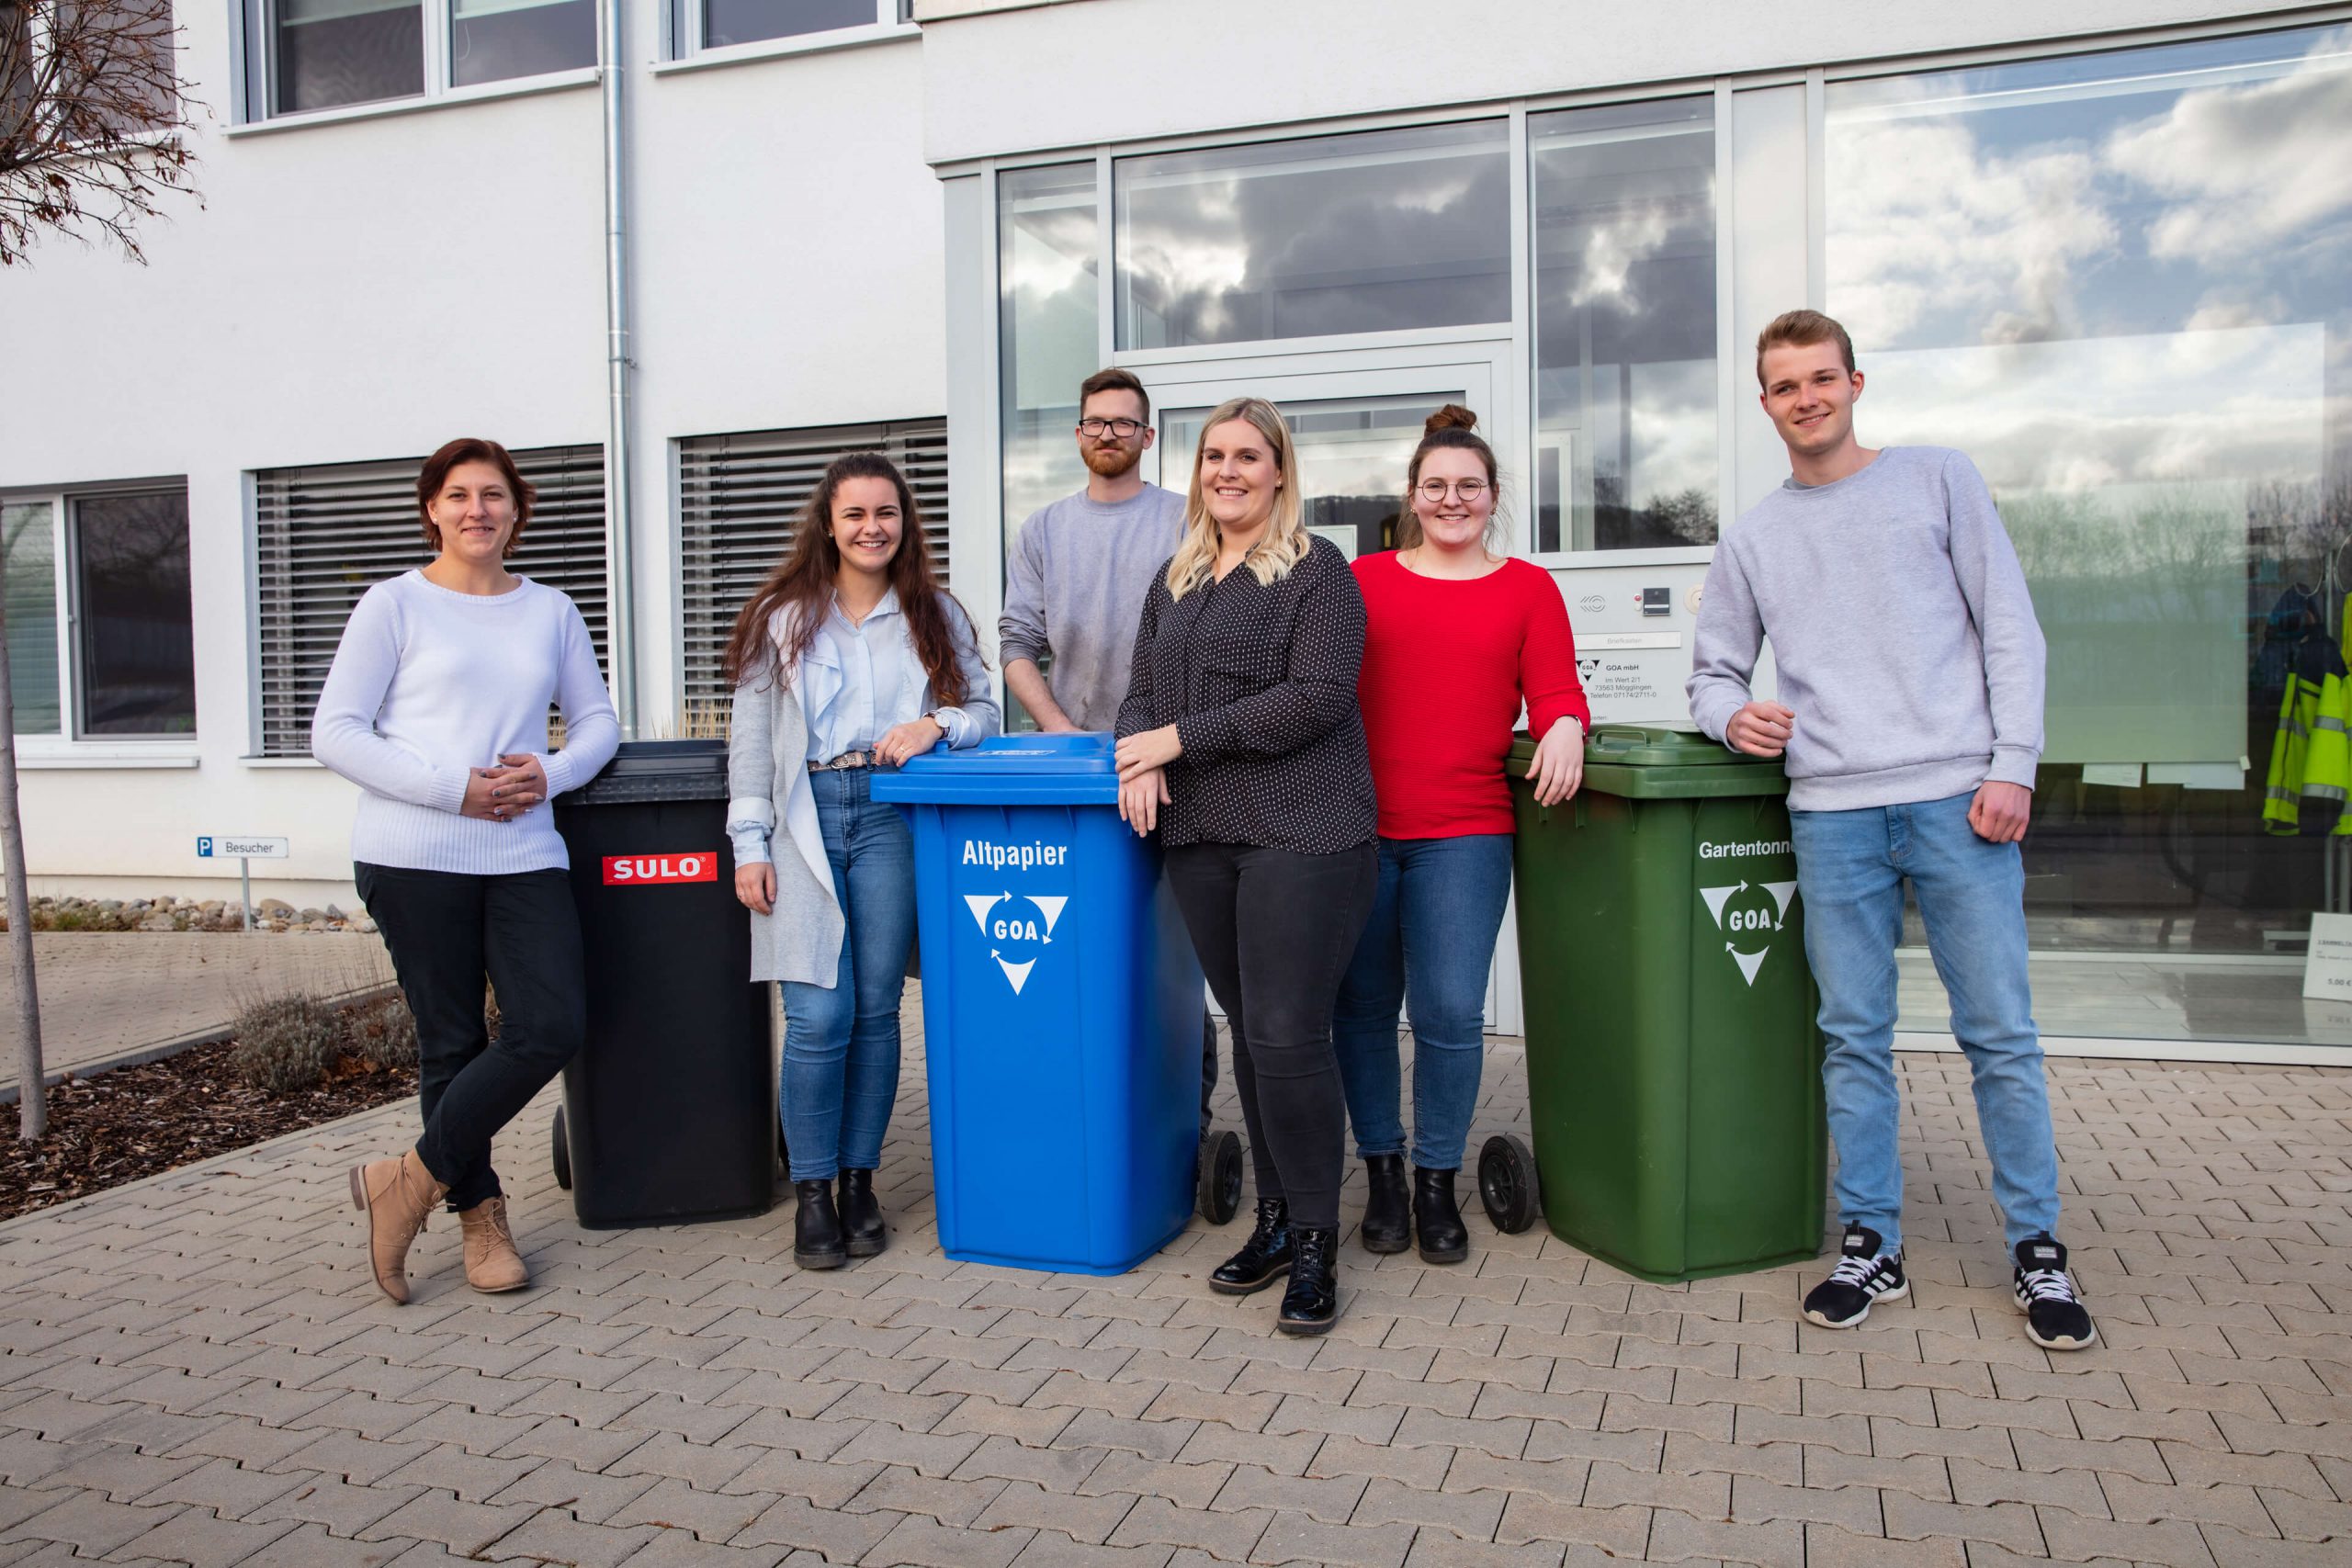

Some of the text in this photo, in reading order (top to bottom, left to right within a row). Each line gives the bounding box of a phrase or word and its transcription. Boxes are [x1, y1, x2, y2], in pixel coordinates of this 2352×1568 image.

[199, 839, 274, 855] P Besucher
[962, 840, 1068, 871] Altpapier
[994, 919, 1038, 941] GOA
[1729, 908, 1771, 931] GOA
